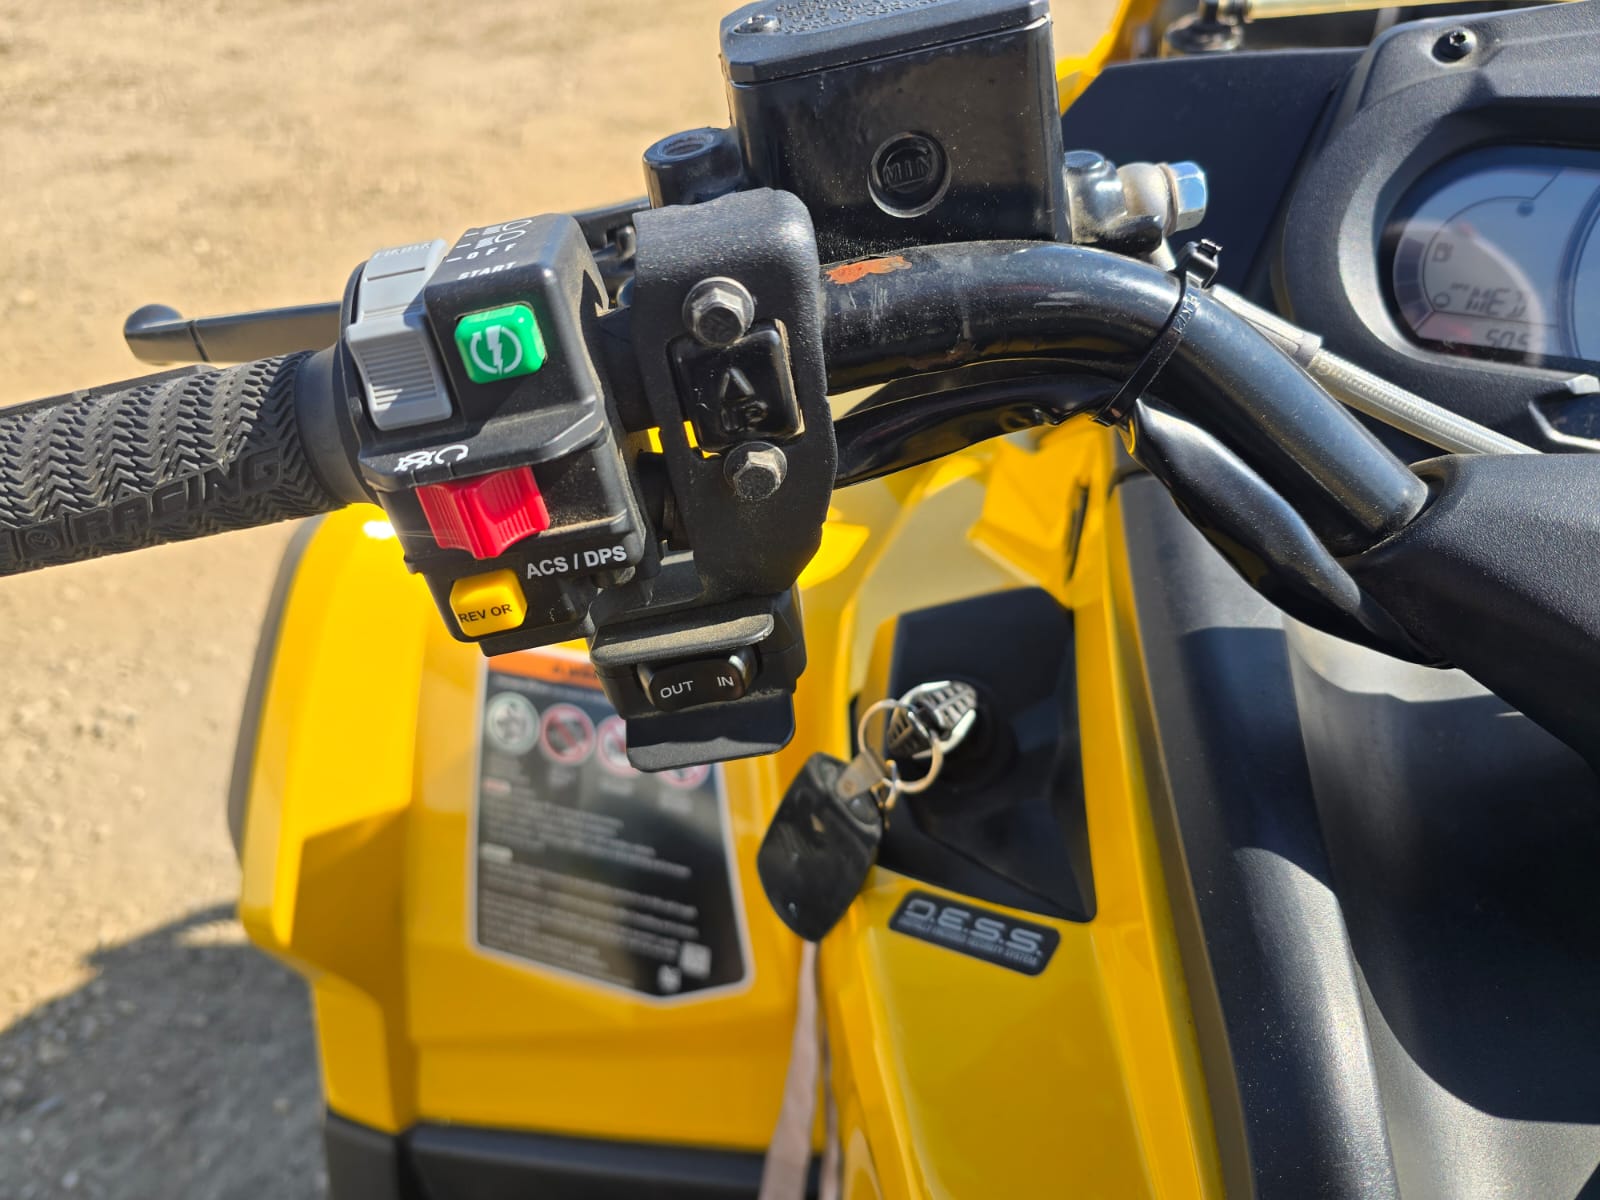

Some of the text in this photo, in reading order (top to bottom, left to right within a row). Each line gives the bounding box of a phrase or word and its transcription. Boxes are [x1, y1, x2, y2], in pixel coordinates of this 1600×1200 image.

[885, 155, 930, 185] MIN
[466, 242, 517, 260] OFF
[457, 261, 517, 281] START
[526, 556, 569, 580] ACS
[583, 545, 628, 568] DPS
[458, 603, 513, 624] REV OR
[660, 676, 735, 699] OUT IN
